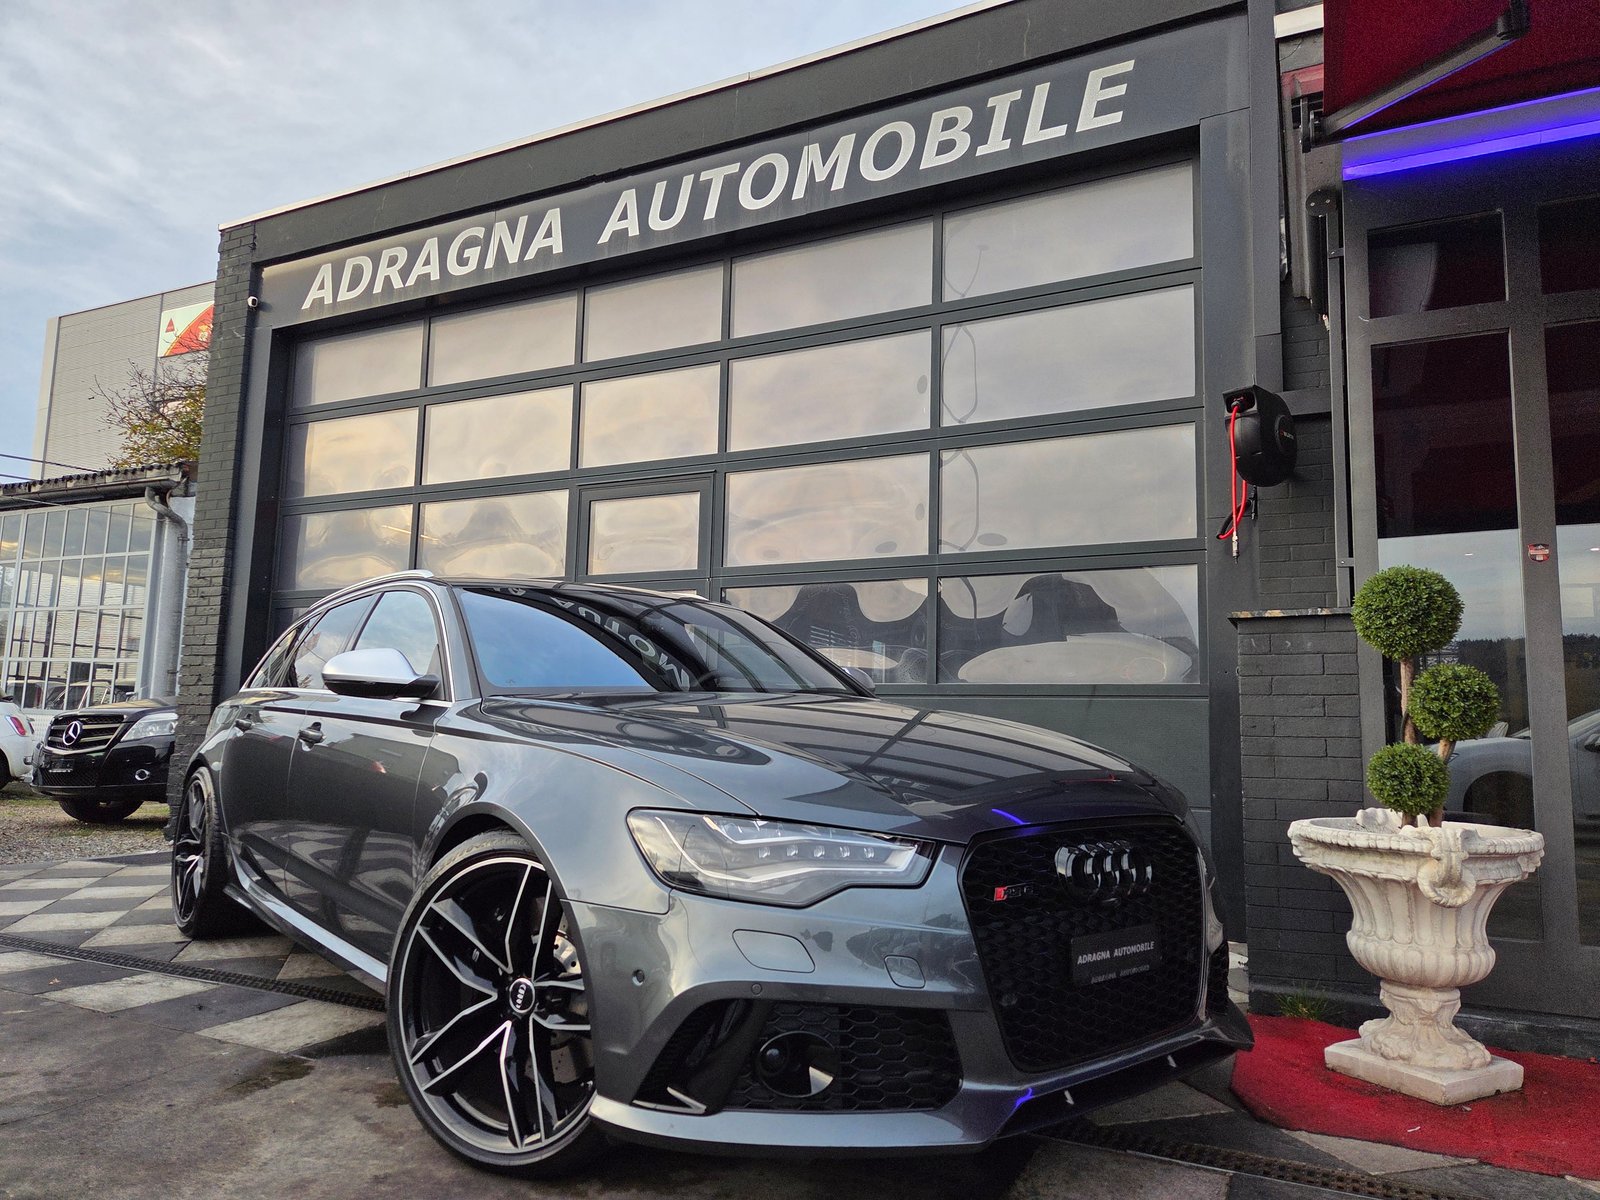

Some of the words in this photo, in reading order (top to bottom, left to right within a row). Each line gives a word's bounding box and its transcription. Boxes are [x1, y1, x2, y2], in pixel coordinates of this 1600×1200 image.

[301, 207, 563, 310] ADRAGNA
[597, 59, 1136, 244] AUTOMOBILE
[1077, 950, 1111, 965] ADRAGNA
[1113, 941, 1155, 957] AUTOMOBILE
